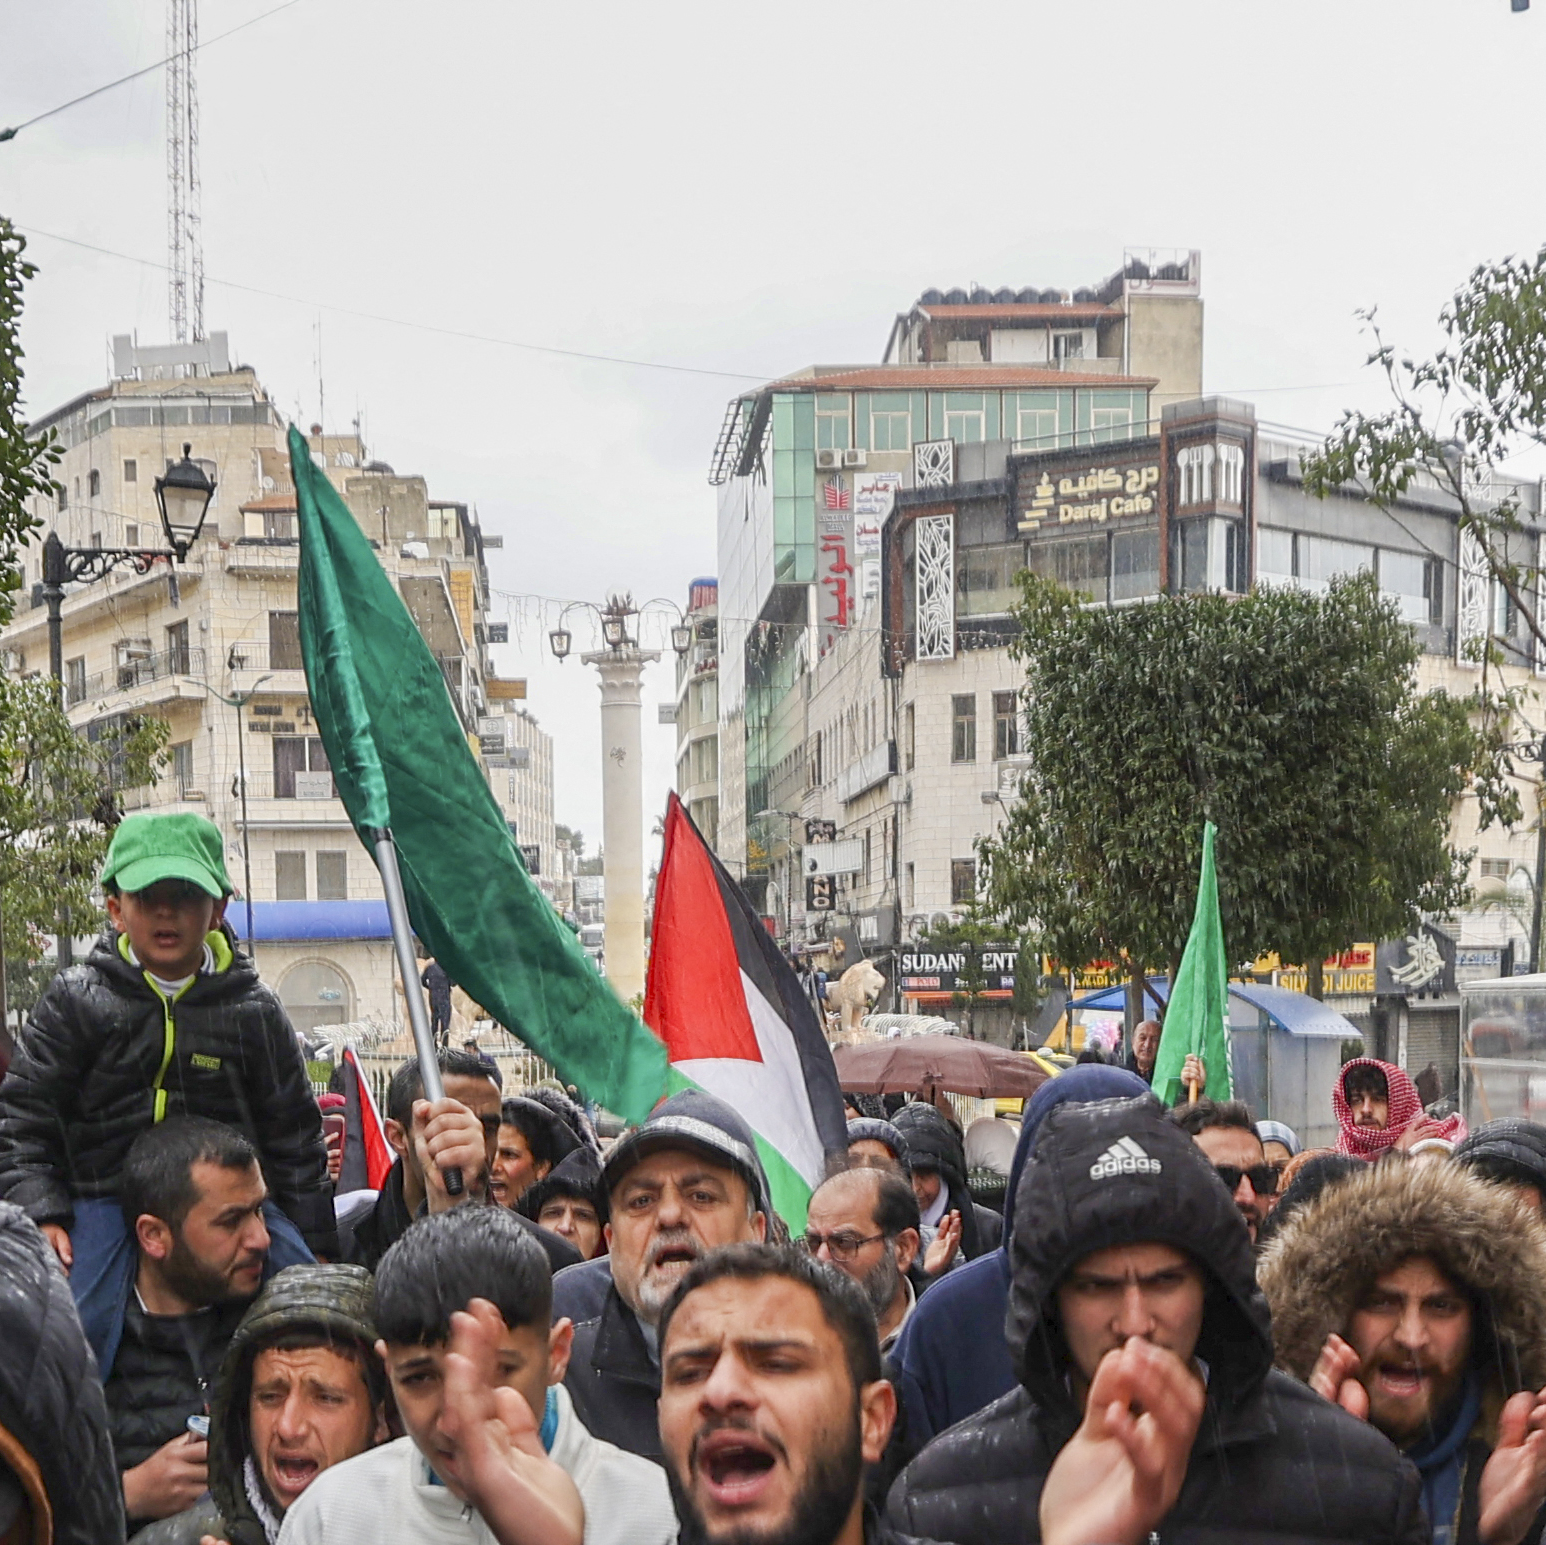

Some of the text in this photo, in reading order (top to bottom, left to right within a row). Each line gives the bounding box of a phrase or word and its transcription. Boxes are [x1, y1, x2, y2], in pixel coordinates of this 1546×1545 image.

[1059, 466, 1159, 499] درج كافيه
[1059, 498, 1107, 524] Daraj
[1336, 973, 1376, 991] JUICE
[1089, 1155, 1162, 1181] adidas
